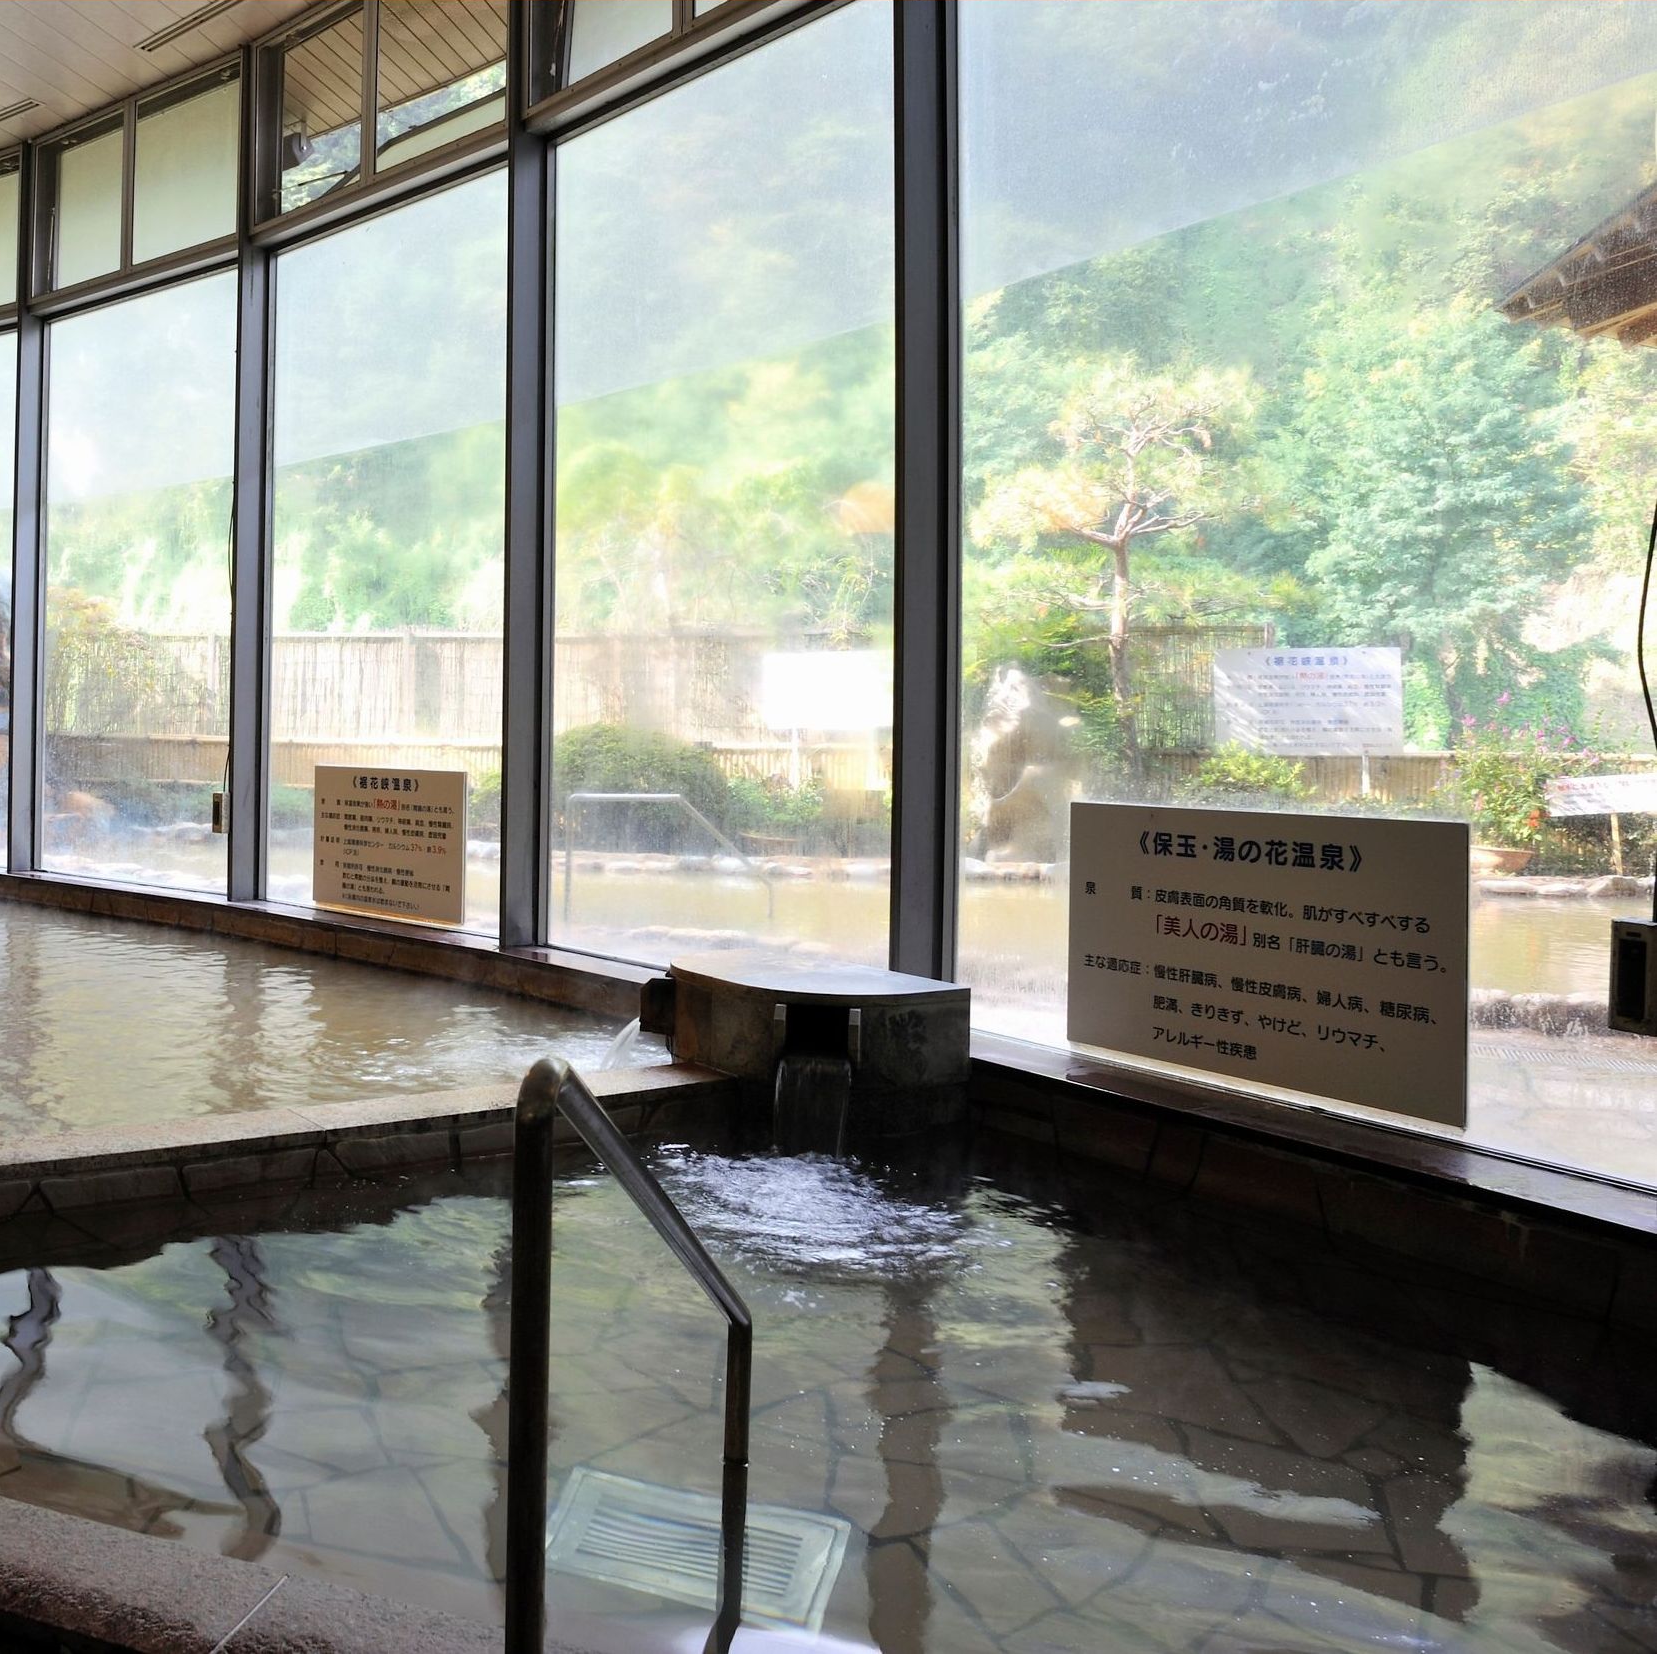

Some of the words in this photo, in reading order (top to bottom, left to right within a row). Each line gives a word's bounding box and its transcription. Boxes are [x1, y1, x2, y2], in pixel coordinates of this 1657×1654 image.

[1138, 831, 1363, 873] 《保玉・湯の花温泉》
[1084, 881, 1096, 895] 泉
[1151, 1025, 1258, 1061] アレルギー性疾患
